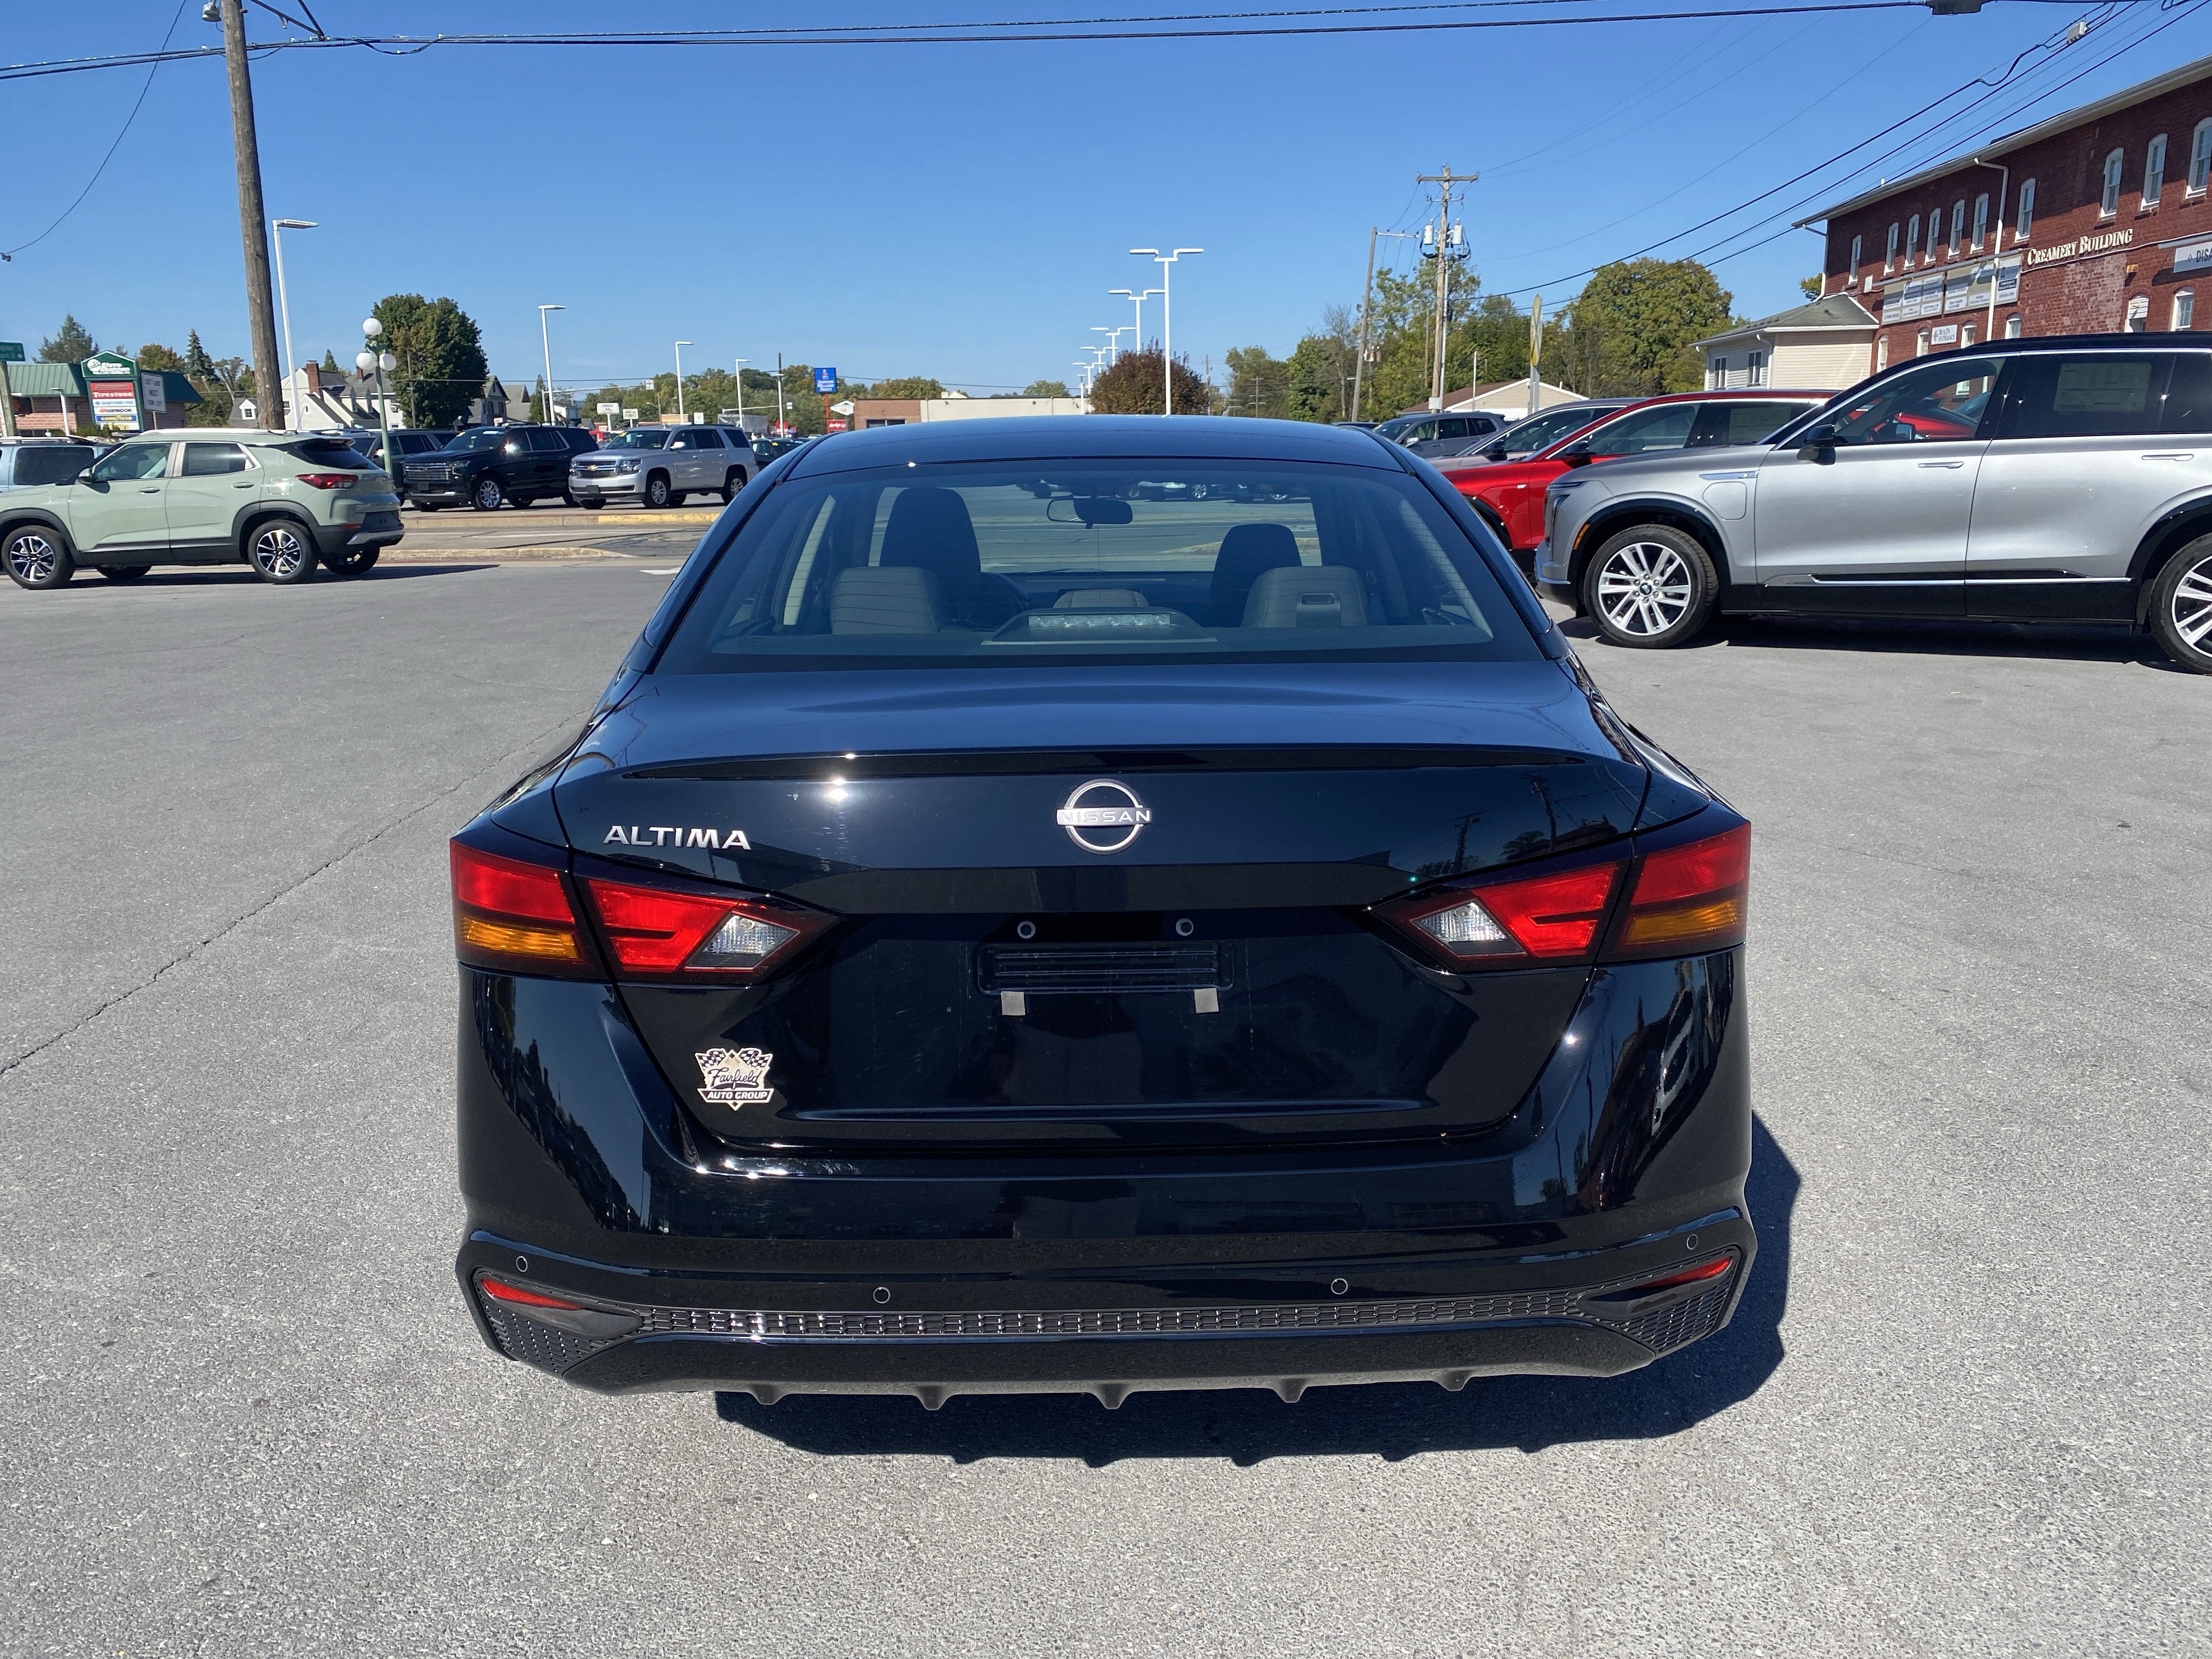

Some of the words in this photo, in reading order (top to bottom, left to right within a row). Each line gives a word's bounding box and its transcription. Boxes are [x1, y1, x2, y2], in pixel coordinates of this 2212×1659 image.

[1059, 810, 1150, 823] NISSAN
[603, 825, 752, 851] ALTIMA
[707, 1067, 763, 1088] Fairfield
